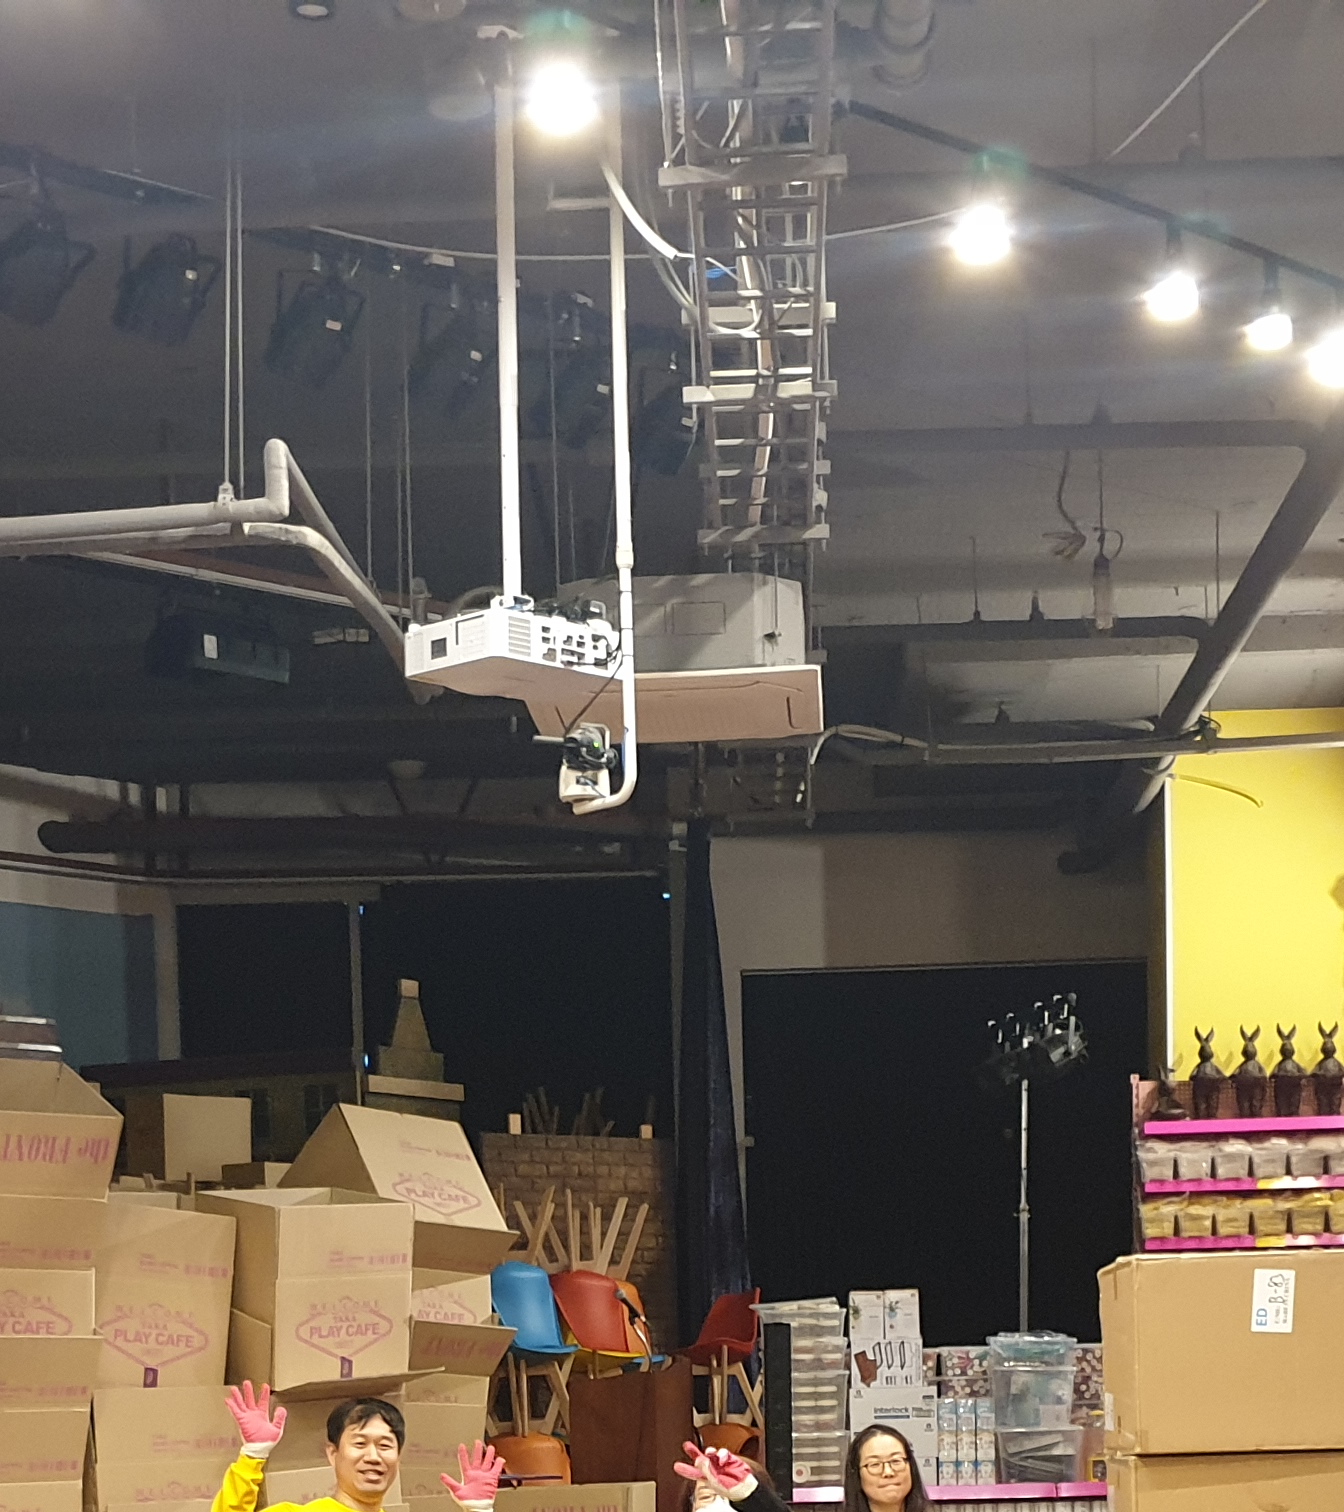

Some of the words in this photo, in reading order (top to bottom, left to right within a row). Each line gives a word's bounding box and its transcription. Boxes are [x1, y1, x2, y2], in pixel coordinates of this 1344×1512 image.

[1256, 1308, 1267, 1326] ED
[11, 1320, 56, 1335] CAFE
[309, 1324, 343, 1340] PLAY
[345, 1322, 381, 1337] CAFE
[114, 1328, 152, 1345] PLAY
[156, 1331, 196, 1348] CAFE
